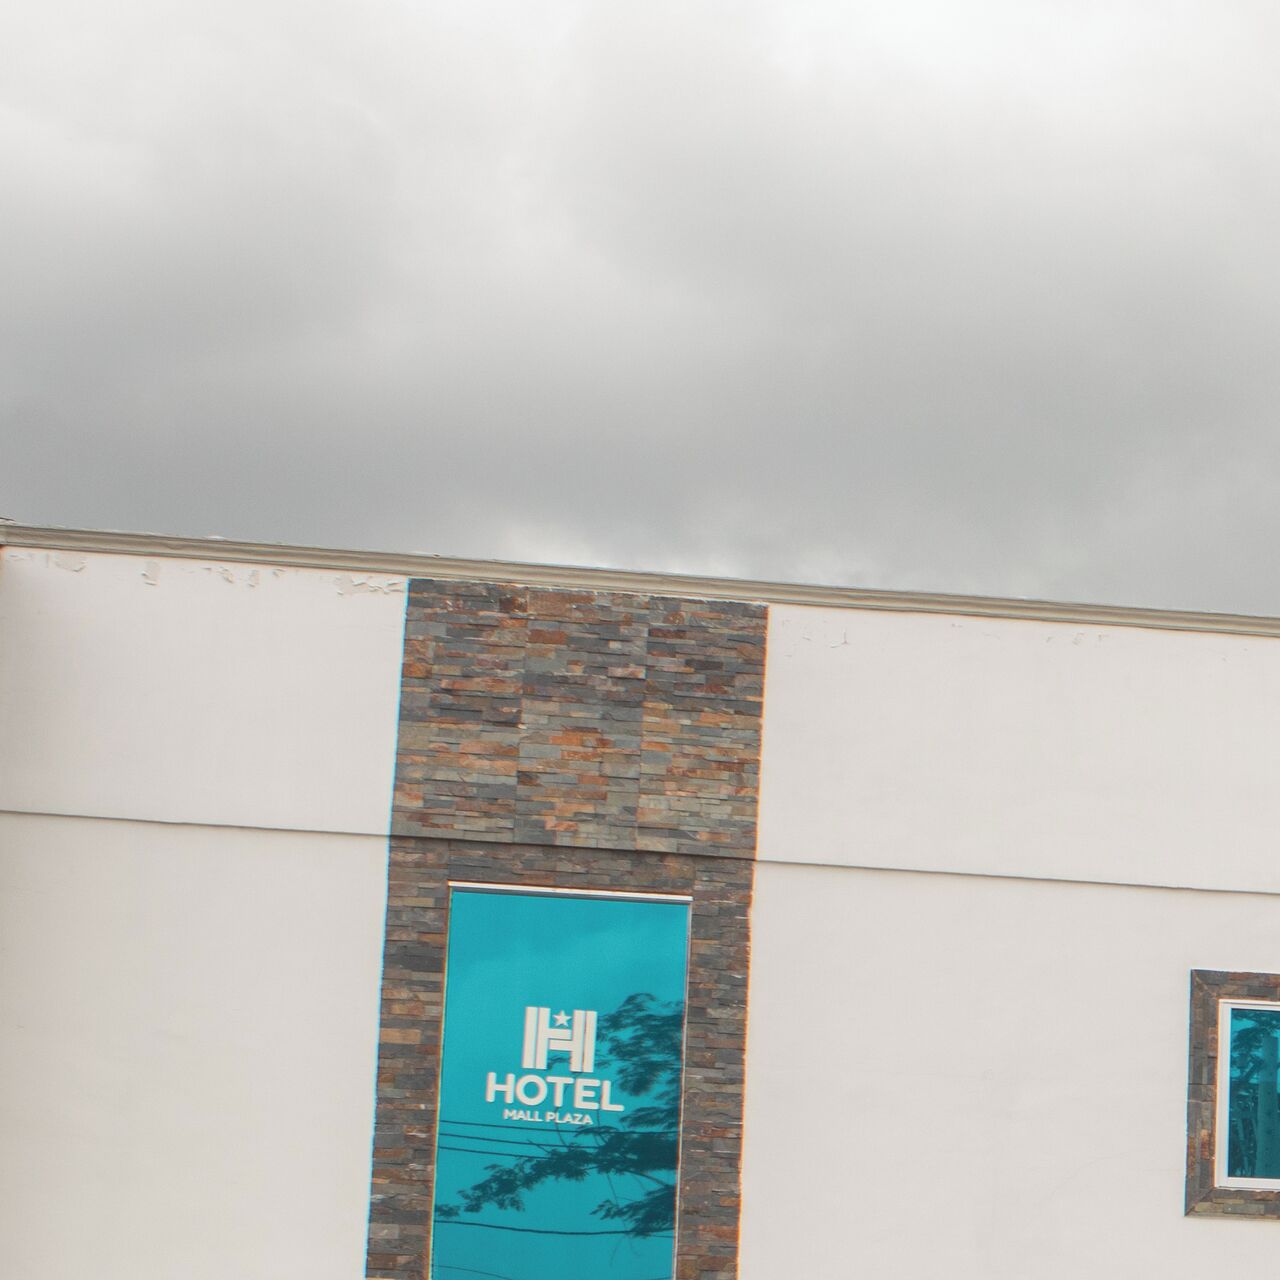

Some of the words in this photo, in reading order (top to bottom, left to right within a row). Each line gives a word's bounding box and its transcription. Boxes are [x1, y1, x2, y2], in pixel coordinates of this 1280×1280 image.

[485, 1072, 625, 1112] HOTEL
[503, 1109, 543, 1123] MALL
[546, 1111, 594, 1125] PLAZA
